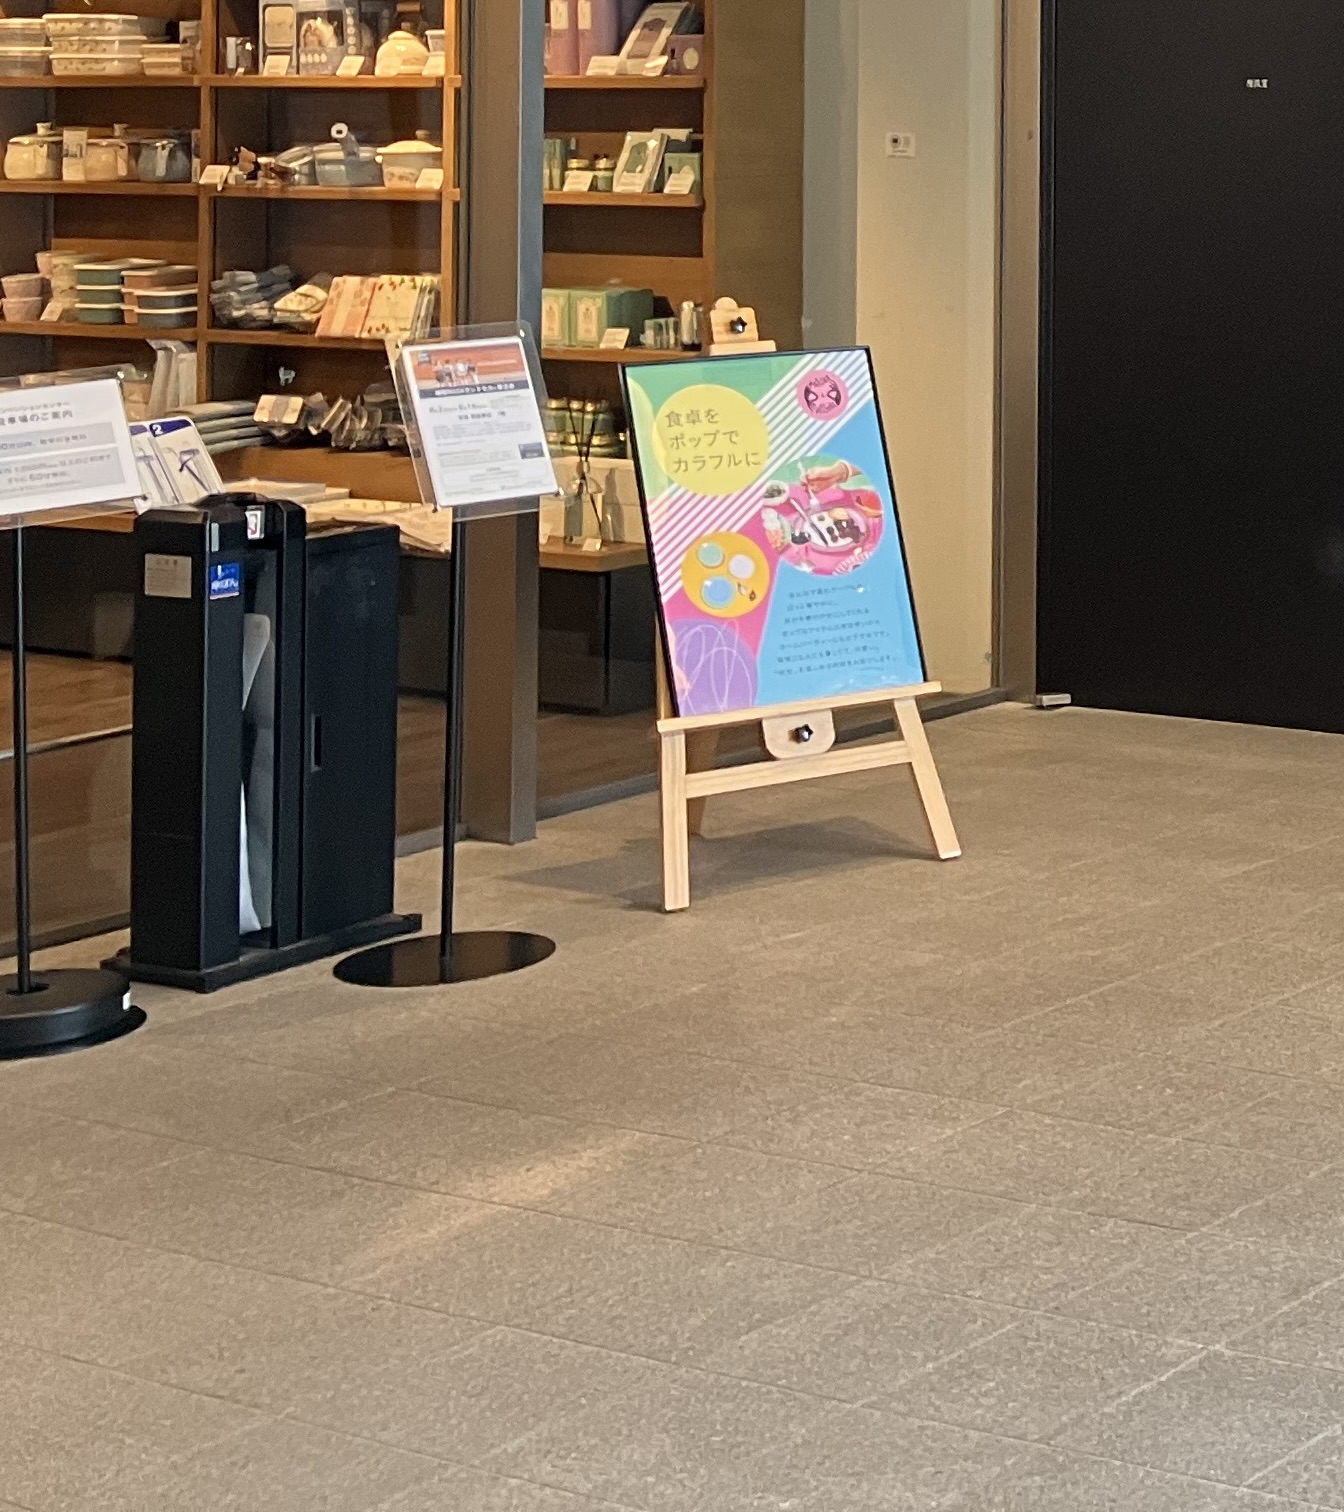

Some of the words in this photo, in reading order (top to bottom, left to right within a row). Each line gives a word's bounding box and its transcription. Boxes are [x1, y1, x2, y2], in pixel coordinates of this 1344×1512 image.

[664, 408, 720, 428] 食卓を
[152, 424, 164, 436] 2
[669, 429, 740, 450] ポップで
[673, 452, 762, 474] カラフルに
